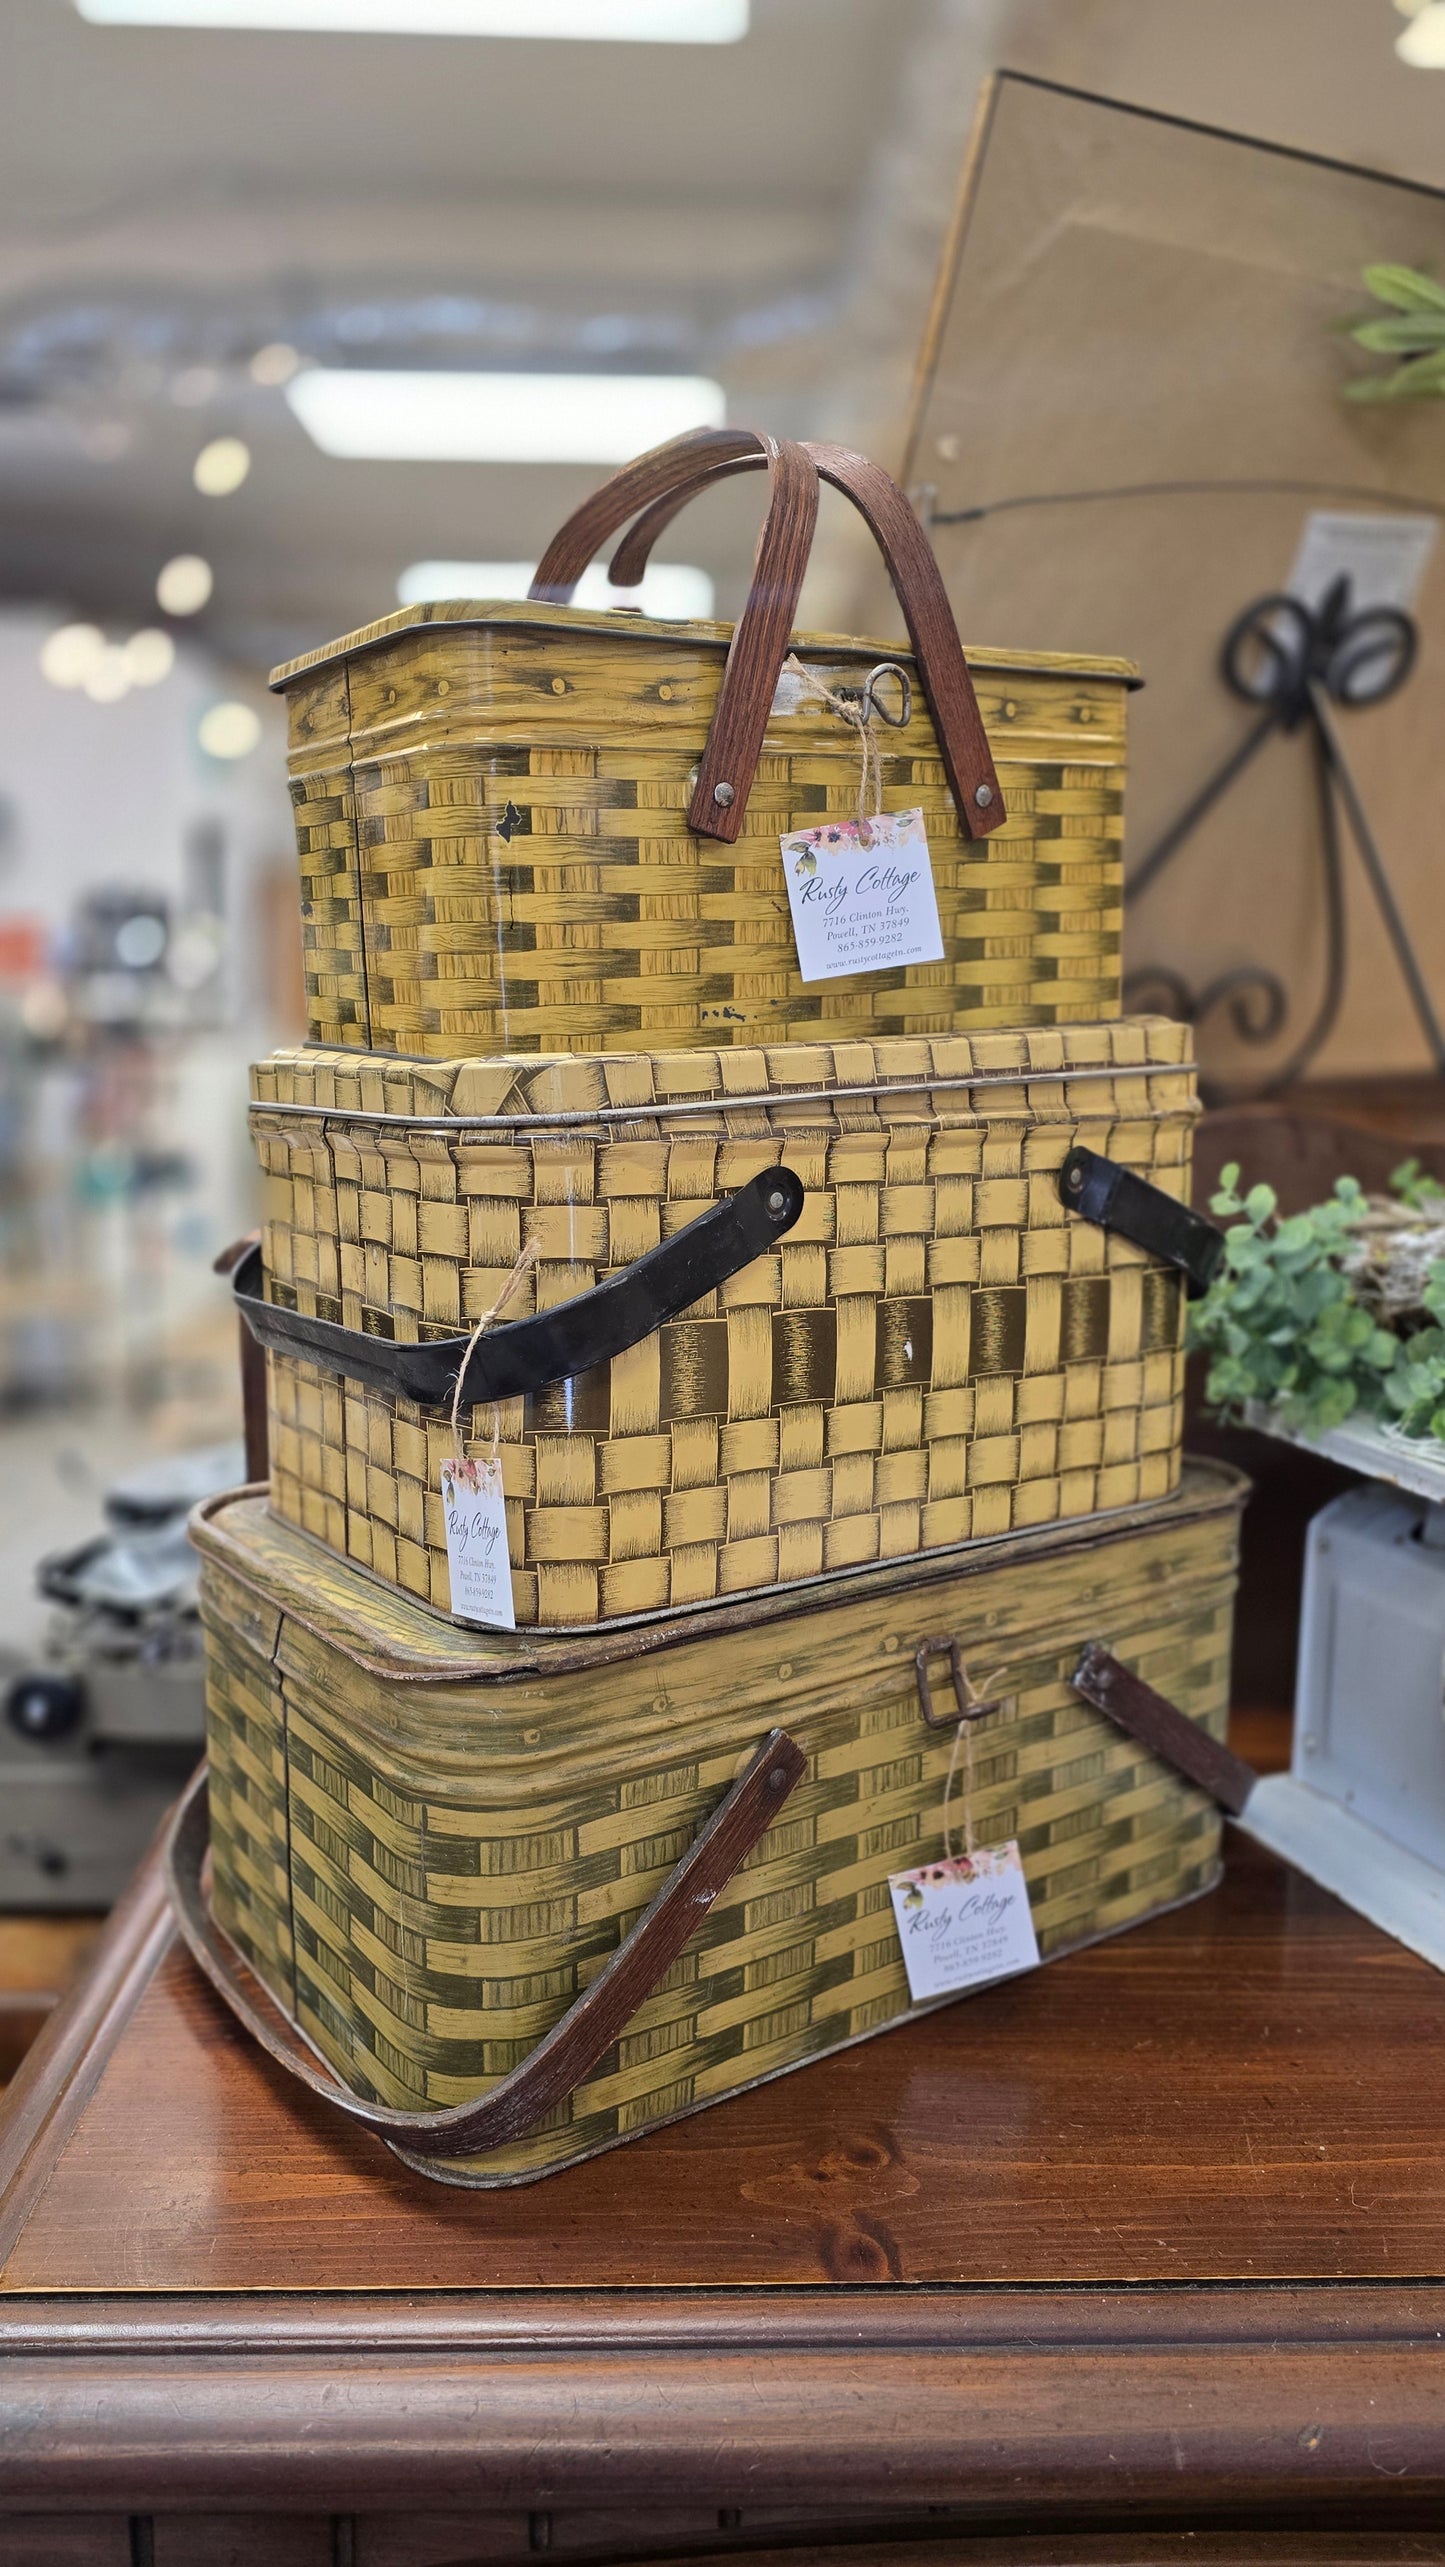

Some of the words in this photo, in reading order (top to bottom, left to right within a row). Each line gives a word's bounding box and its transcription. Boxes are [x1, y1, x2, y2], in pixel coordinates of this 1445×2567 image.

[799, 876, 848, 916] Rusty
[855, 865, 921, 904] Cottage
[823, 914, 847, 928] 7716
[849, 910, 882, 923] Clinton
[886, 905, 909, 916] Hwy.
[827, 927, 858, 941] Powell,
[861, 923, 877, 934] TN
[880, 916, 910, 931] 37849
[448, 1510, 469, 1553] Rusty
[471, 1511, 501, 1556] Cottage
[907, 1907, 953, 1942] Rusty
[958, 1893, 1016, 1925] Cottage
